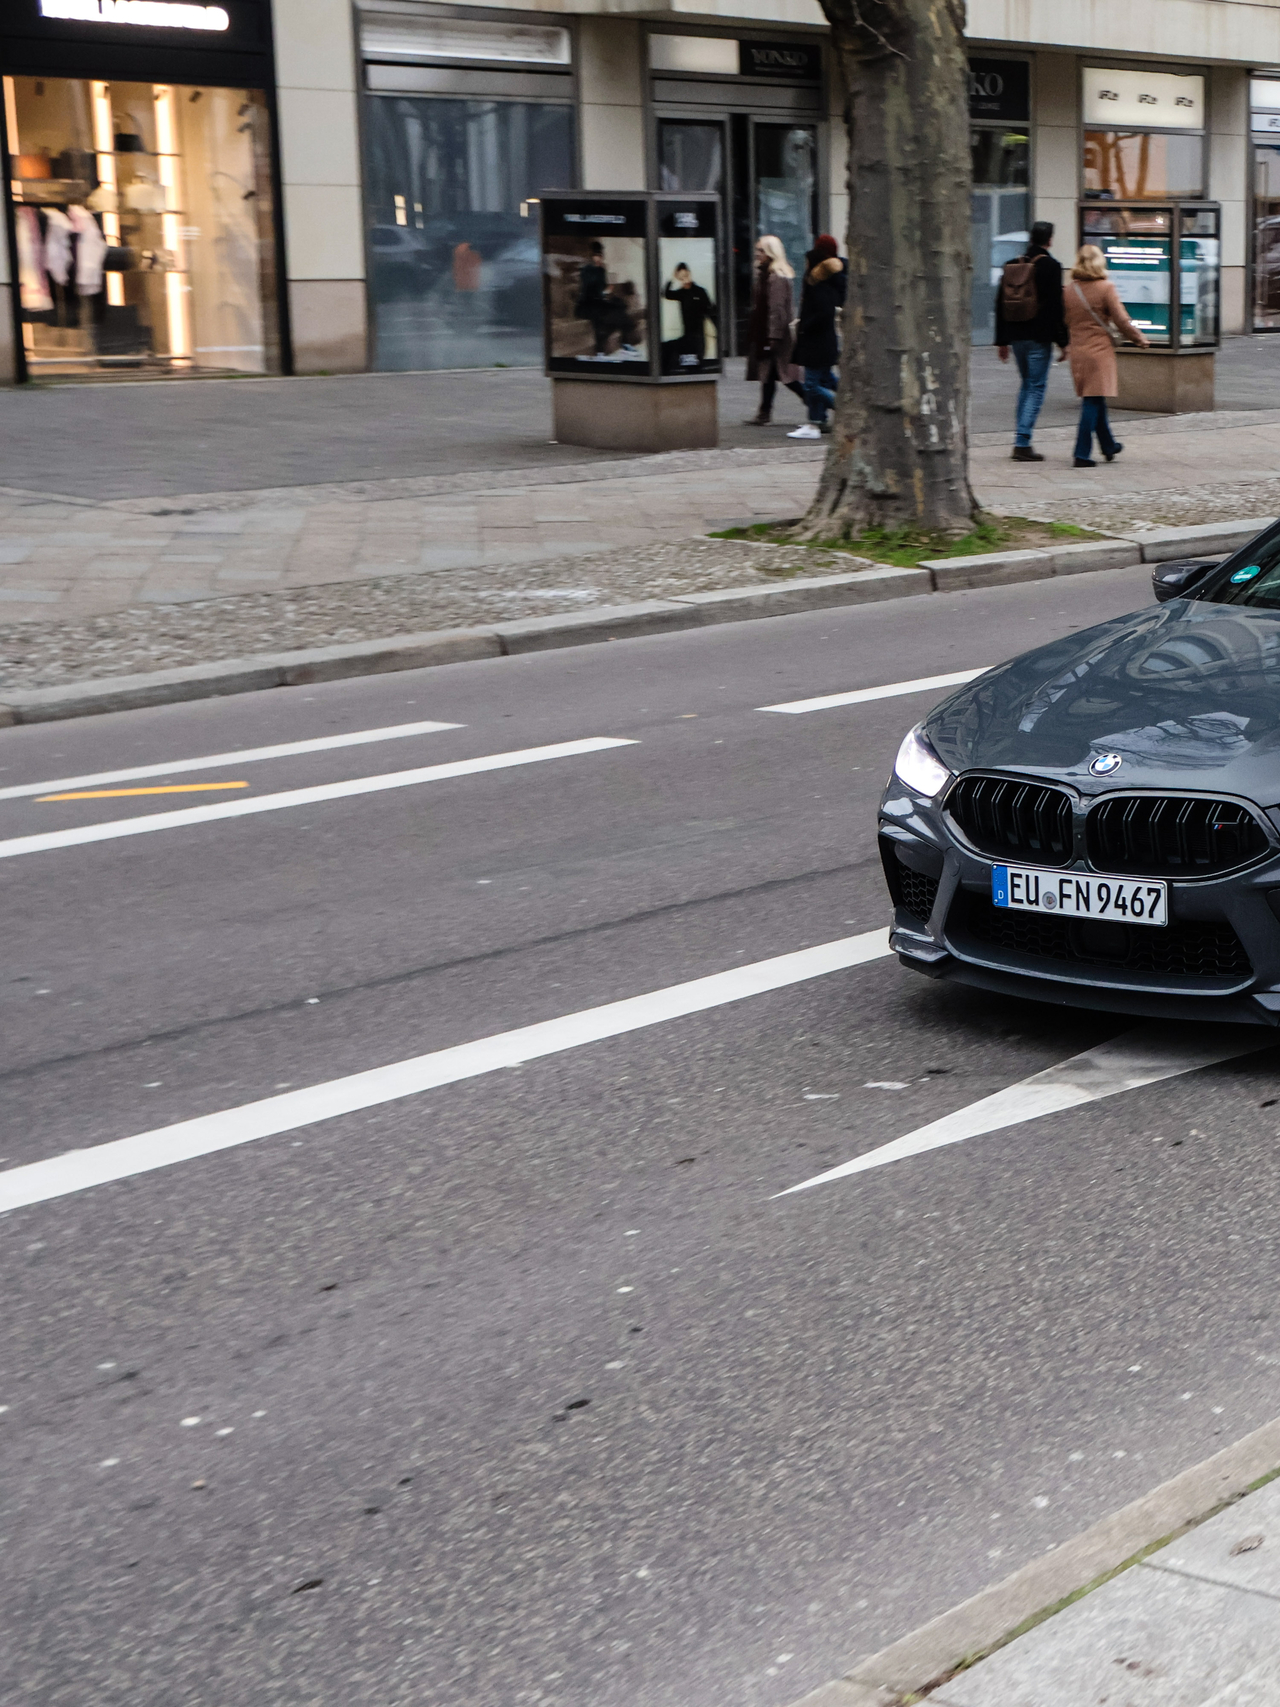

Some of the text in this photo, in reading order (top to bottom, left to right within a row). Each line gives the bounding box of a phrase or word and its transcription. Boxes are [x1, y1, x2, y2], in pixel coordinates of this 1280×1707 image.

[997, 890, 1004, 900] D
[1010, 873, 1161, 918] EU FN 9467
